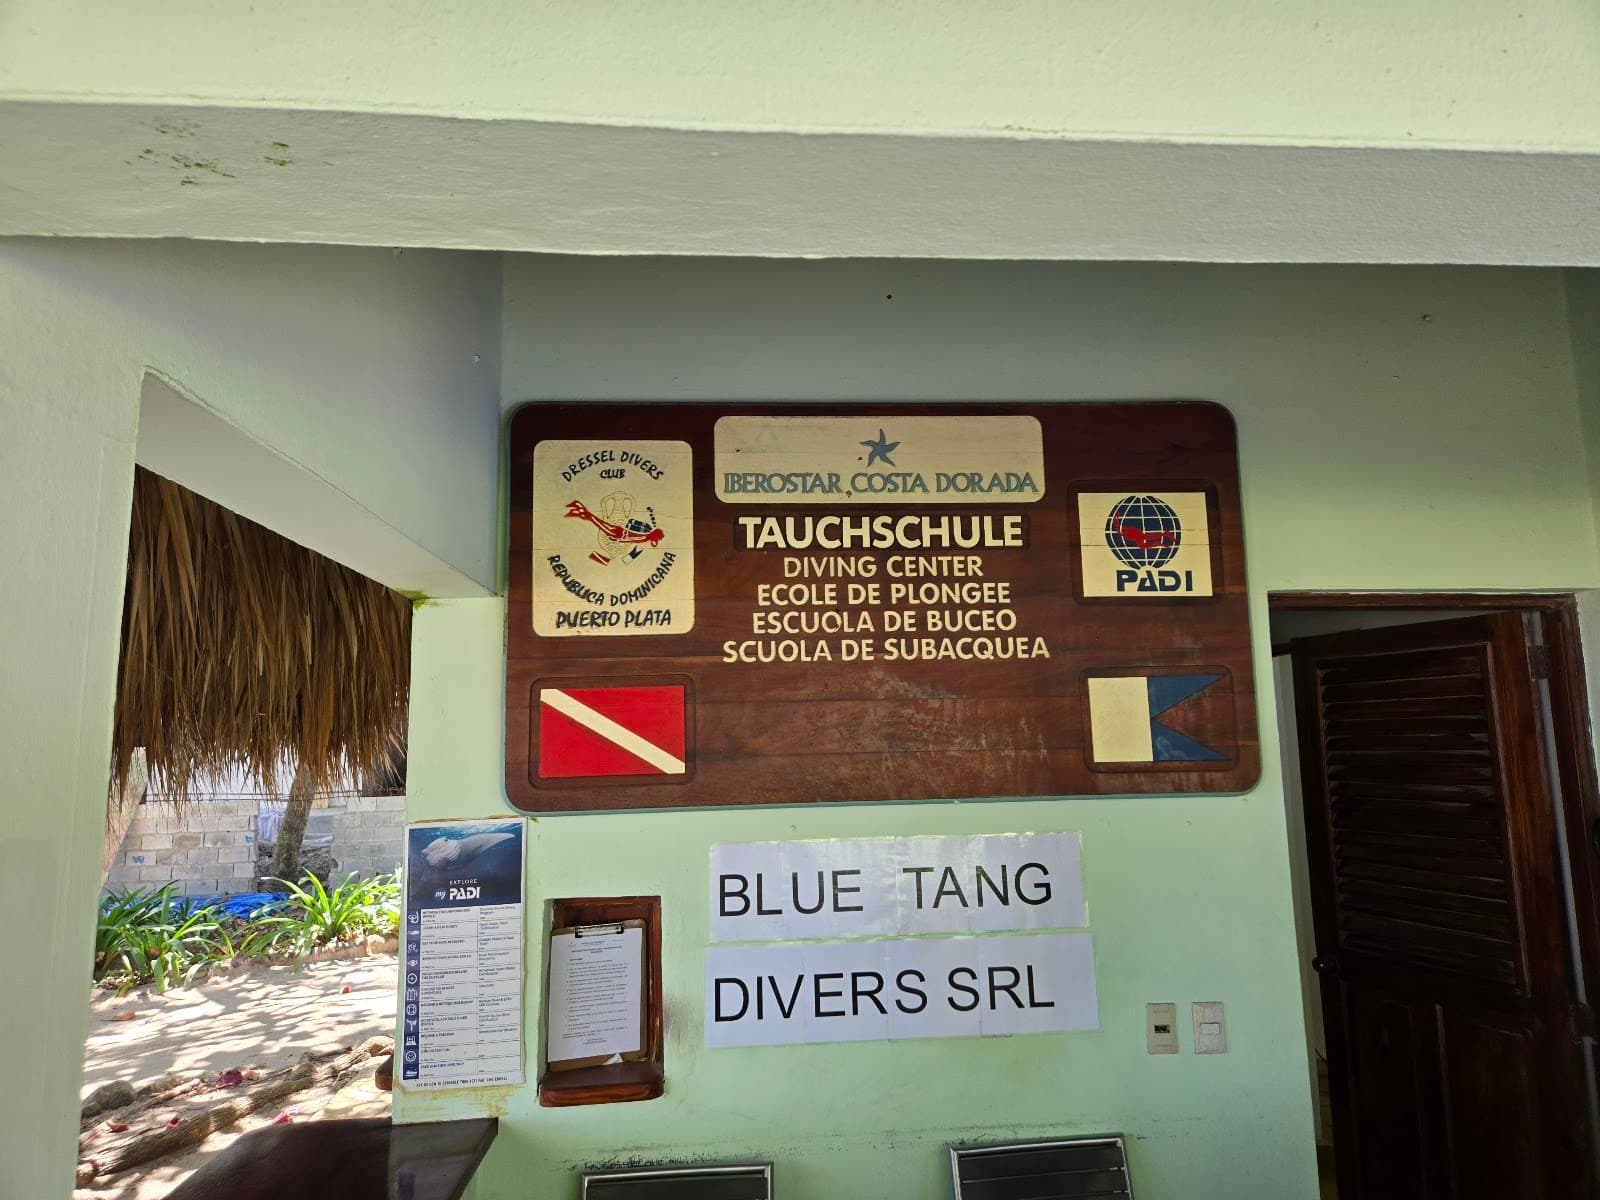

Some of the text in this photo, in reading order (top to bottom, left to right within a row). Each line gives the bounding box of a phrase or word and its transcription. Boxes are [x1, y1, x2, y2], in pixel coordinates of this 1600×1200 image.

[562, 450, 664, 482] DRESSEL DIVERS
[600, 468, 625, 479] CLUB
[724, 471, 1039, 494] IBEROSTAR COSTA DORADA
[738, 515, 1023, 549] TAUCHSCHULE
[547, 551, 676, 607] REPUBLICA DOMINICANA
[784, 556, 984, 578] DIVING CENTER
[1116, 570, 1193, 592] PADI
[757, 582, 1011, 606] ECOLE DE PLONGEE
[556, 609, 671, 629] PUERTO PLATA
[752, 609, 1017, 634] ESCUOLA DE BUCEO
[722, 636, 1050, 662] SCUOLA DE SUBACQUEA
[435, 886, 481, 900] my PADI
[449, 878, 478, 886] EXPLORE
[719, 861, 1052, 916] BLUE TANG
[714, 964, 1055, 1022] DIVERS SRL
